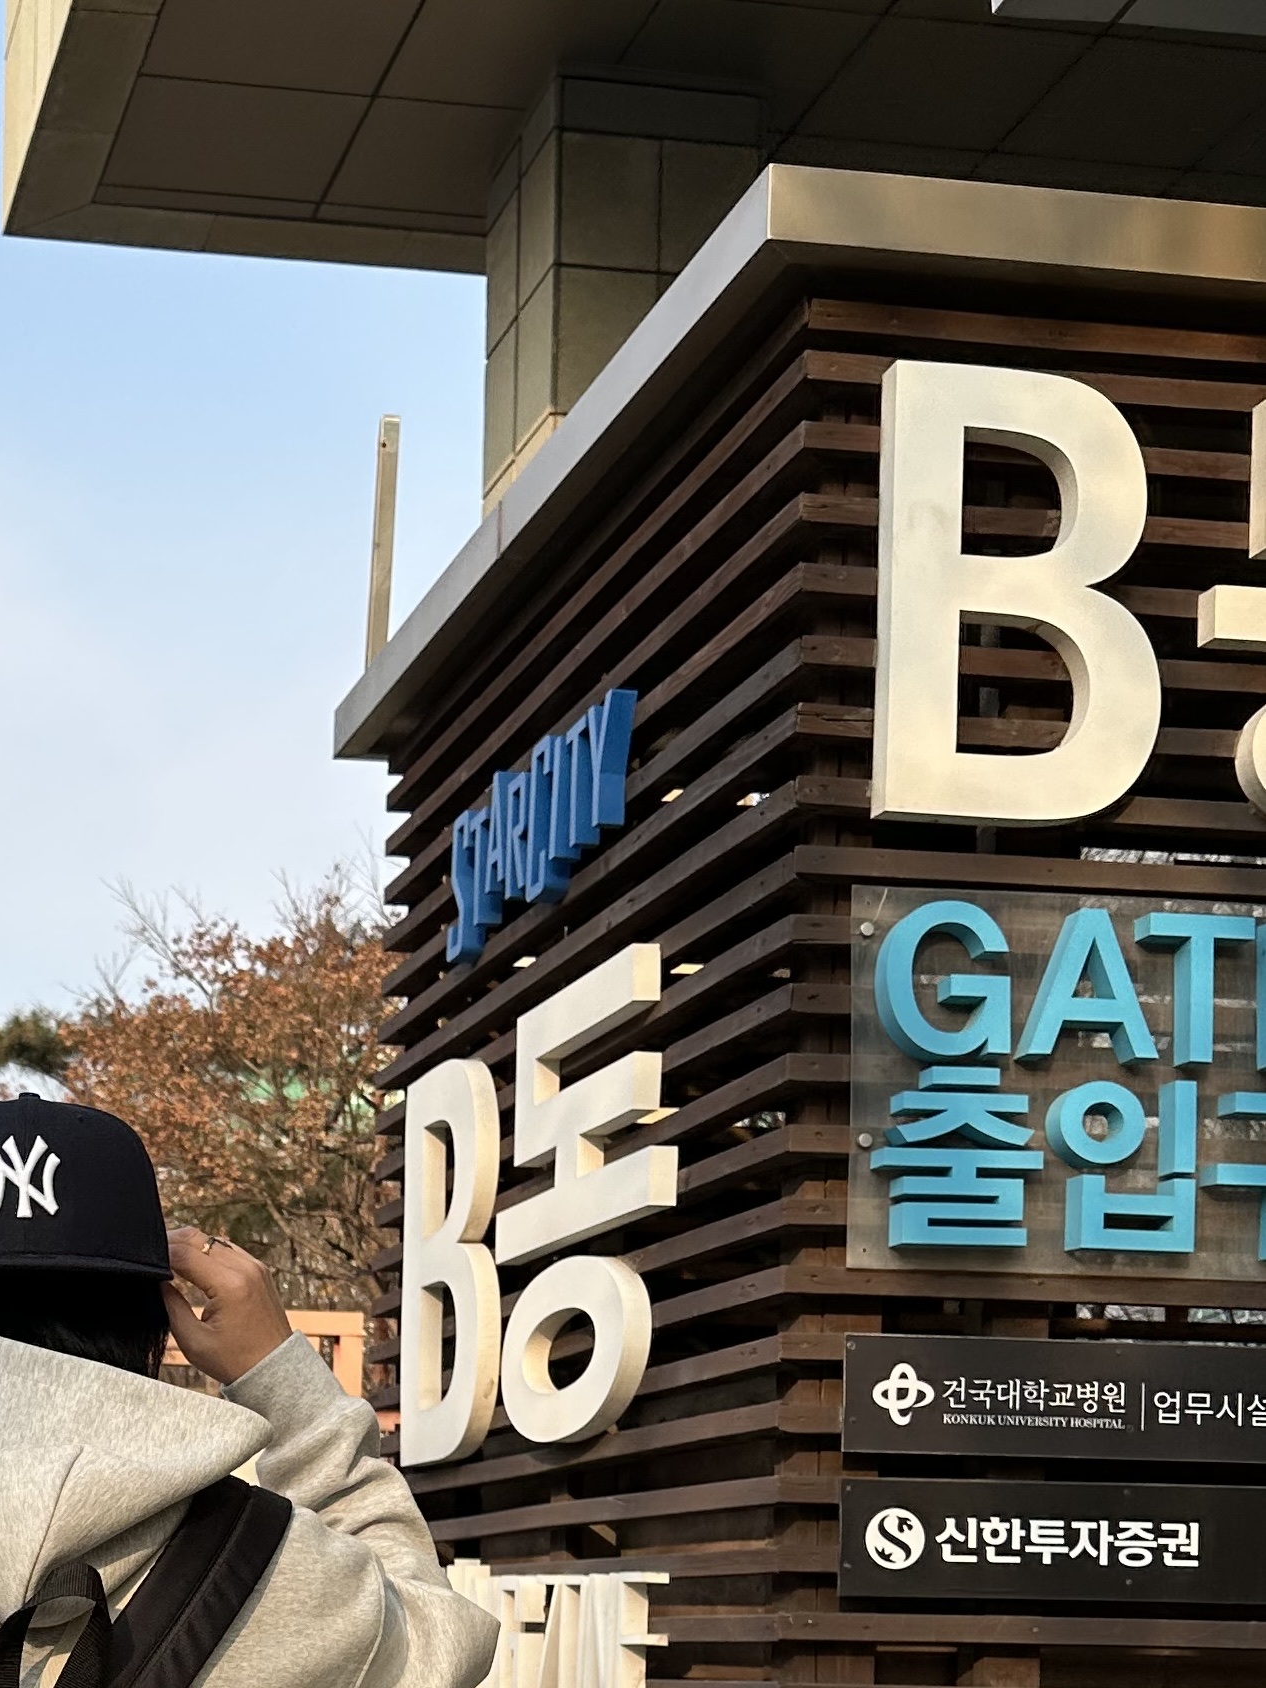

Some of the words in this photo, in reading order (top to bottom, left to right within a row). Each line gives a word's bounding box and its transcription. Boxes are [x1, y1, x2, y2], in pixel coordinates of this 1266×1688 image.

[870, 359, 1266, 828] B
[446, 689, 638, 965] STARCITY
[874, 899, 1266, 1071] GAT
[941, 1376, 1127, 1414] 건국대학교병원
[942, 1413, 996, 1426] KONKUK
[997, 1414, 1069, 1428] UNIVERSITY
[1070, 1417, 1126, 1430] HOSPITAL
[934, 1516, 1201, 1568] 신한투자증권
